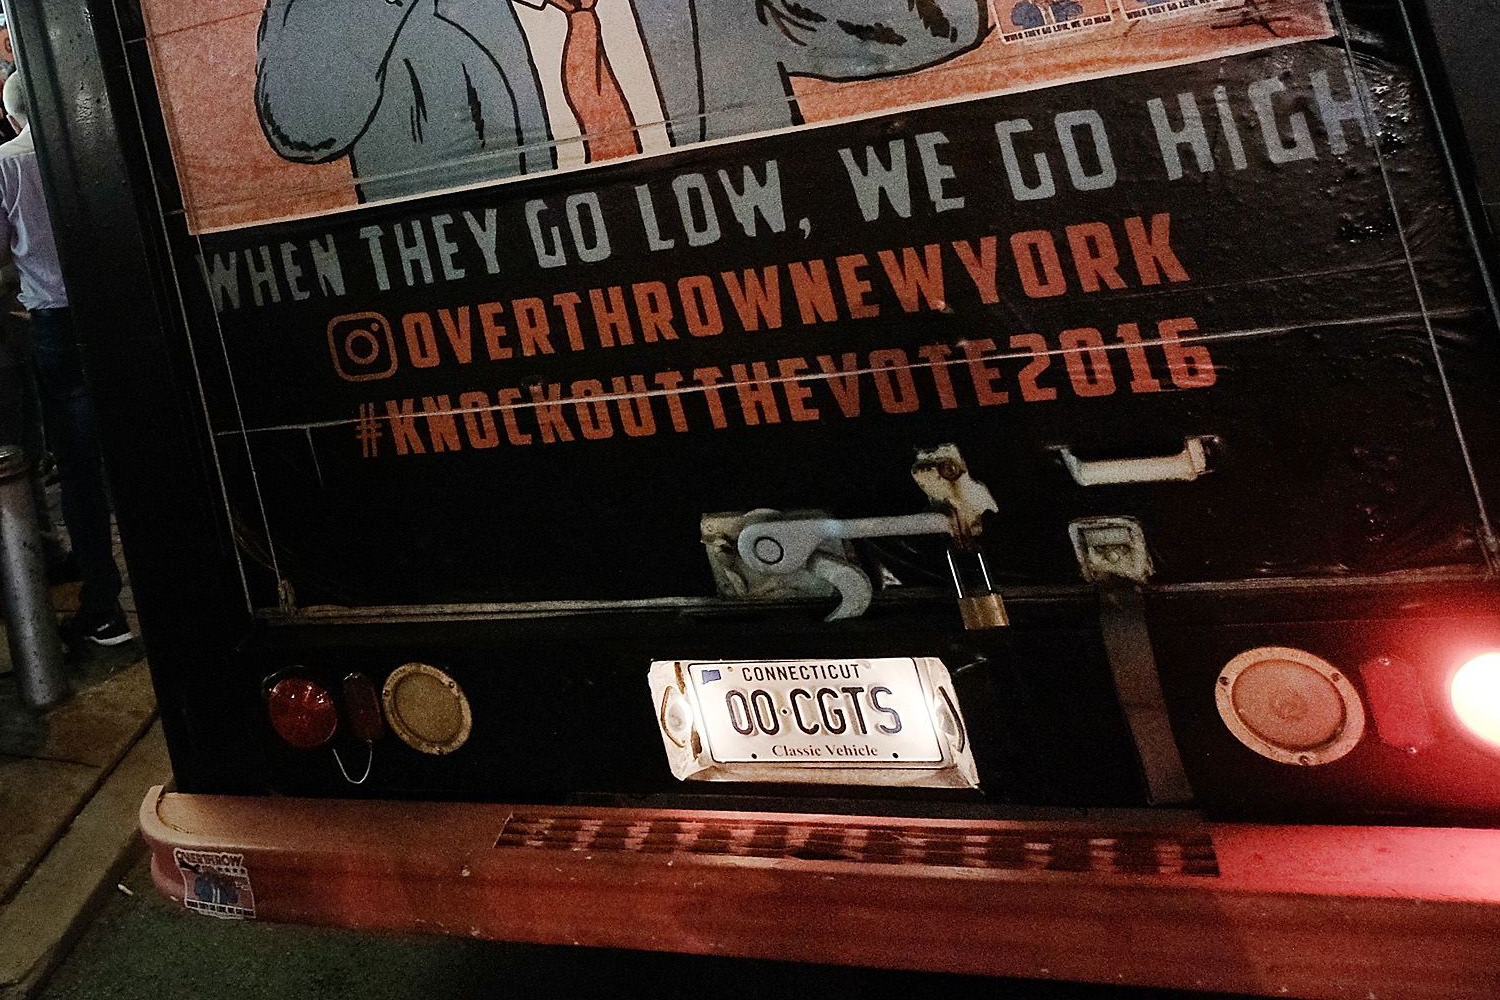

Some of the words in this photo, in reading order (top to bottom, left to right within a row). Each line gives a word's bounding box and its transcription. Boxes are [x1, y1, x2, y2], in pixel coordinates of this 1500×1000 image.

[196, 232, 347, 312] WHEN
[359, 209, 500, 290] THEY
[525, 191, 611, 268] GO
[634, 160, 811, 252] LOW,
[840, 131, 965, 223] WE
[995, 109, 1117, 201] GO
[1147, 68, 1376, 180] HIGH
[401, 212, 1190, 369] OVERTHROWNEWYORK
[355, 317, 1218, 458] #KNOCKOUTTHEVOTE2016
[742, 664, 861, 682] CONNECTICUT
[772, 744, 821, 757] Classic
[825, 744, 879, 757] Vehicle
